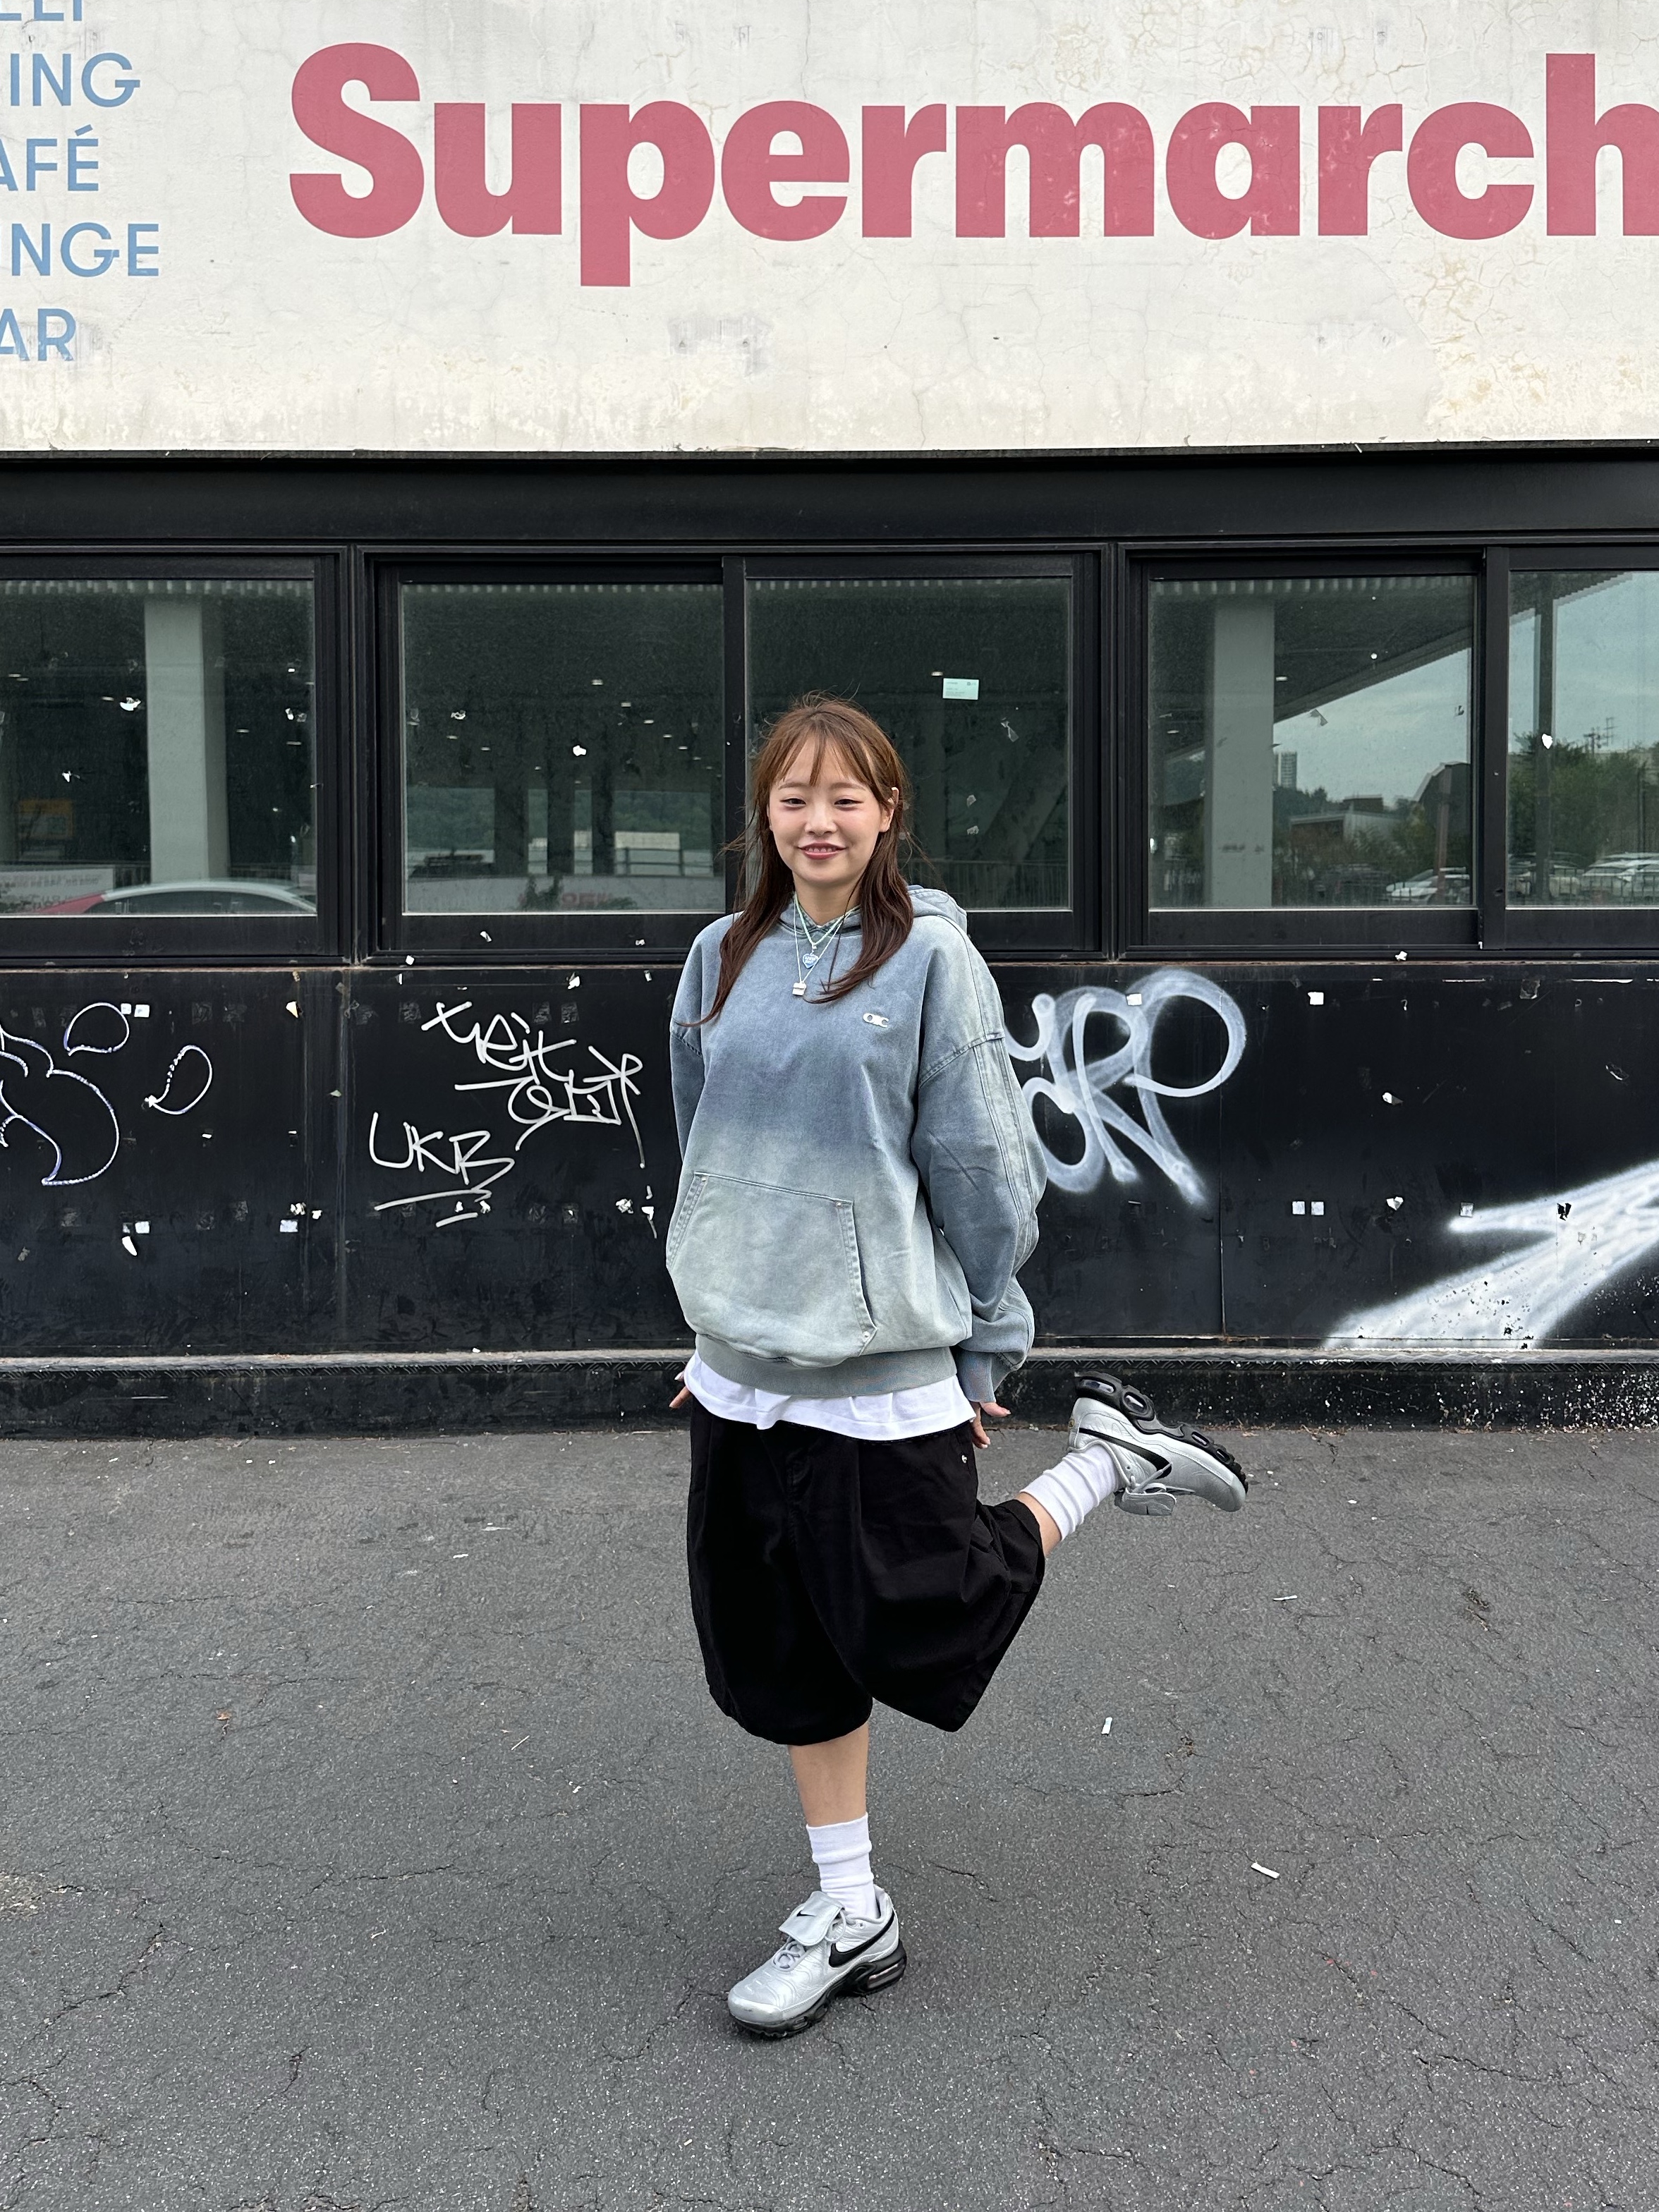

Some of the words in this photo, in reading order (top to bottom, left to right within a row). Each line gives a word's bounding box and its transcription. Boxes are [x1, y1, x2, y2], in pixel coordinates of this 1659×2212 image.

[10, 52, 140, 107] ING
[290, 42, 1659, 286] Supermarch
[11, 222, 159, 277] NGE
